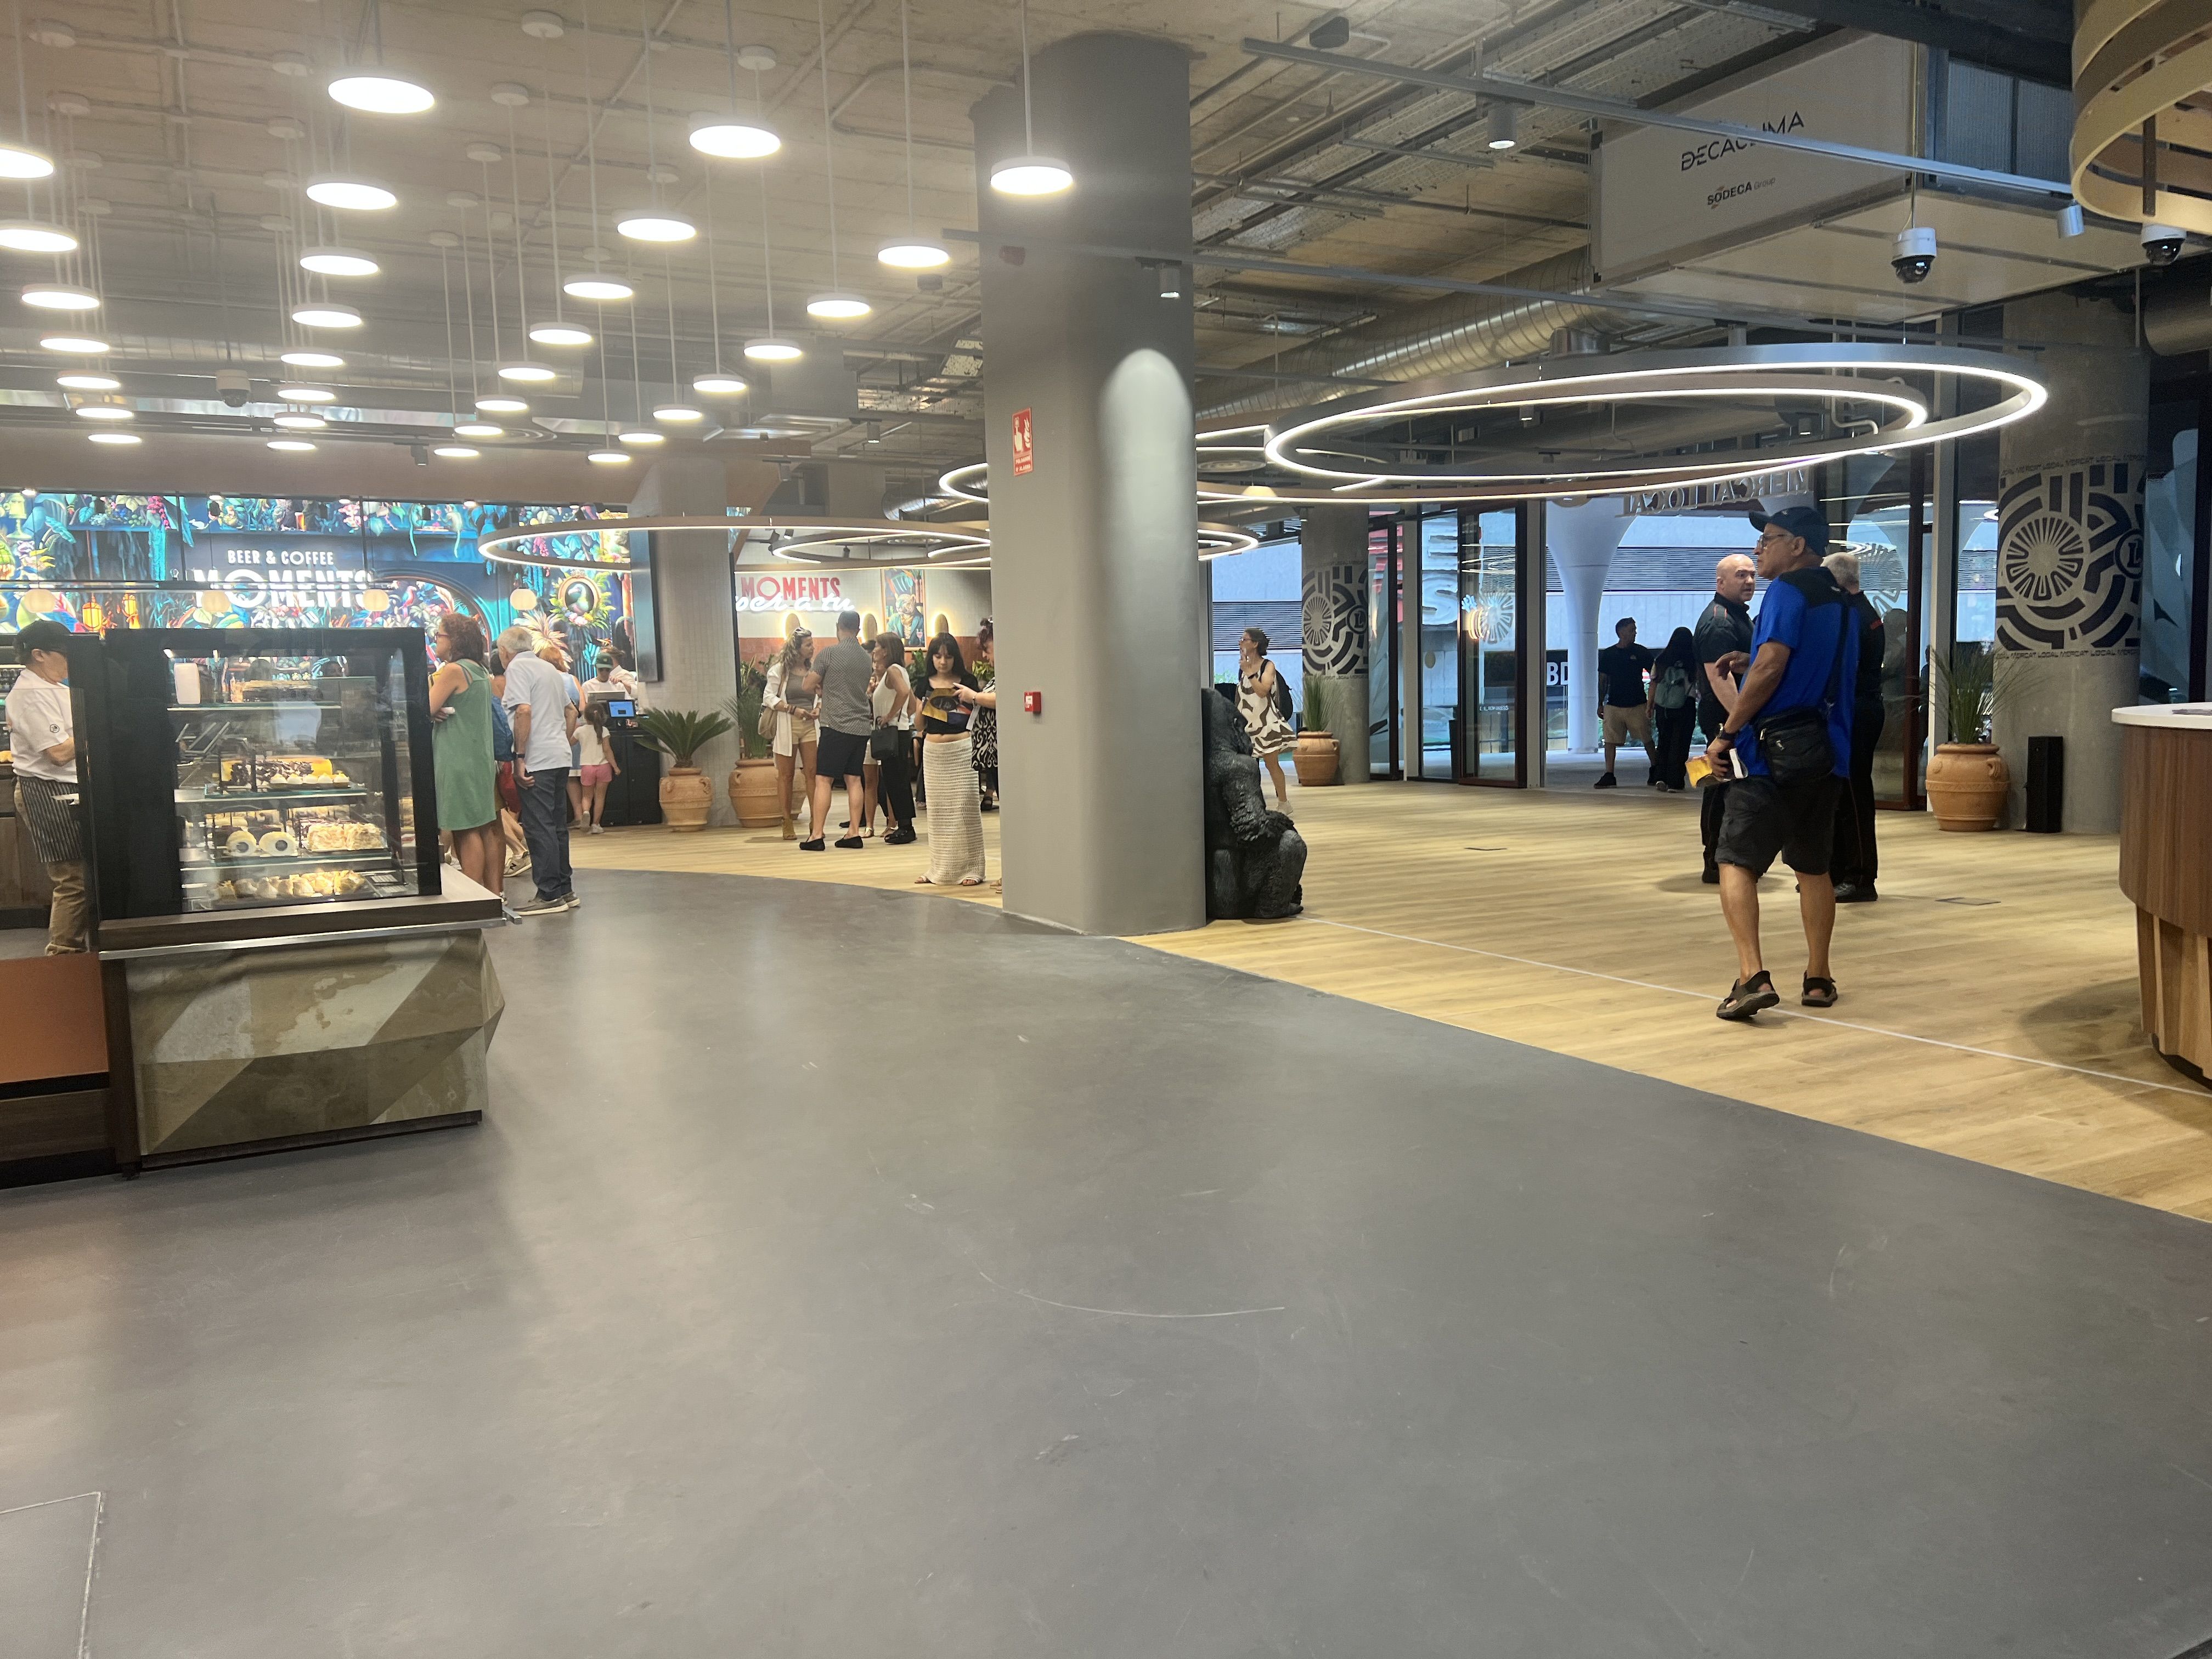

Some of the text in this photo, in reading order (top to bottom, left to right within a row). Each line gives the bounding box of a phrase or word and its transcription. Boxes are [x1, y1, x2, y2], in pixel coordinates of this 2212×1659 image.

[1707, 182, 1752, 206] SODECA
[227, 550, 334, 566] BEER & COFFEE
[741, 576, 841, 601] MOMENTS
[794, 596, 812, 611] a
[821, 592, 855, 611] tu
